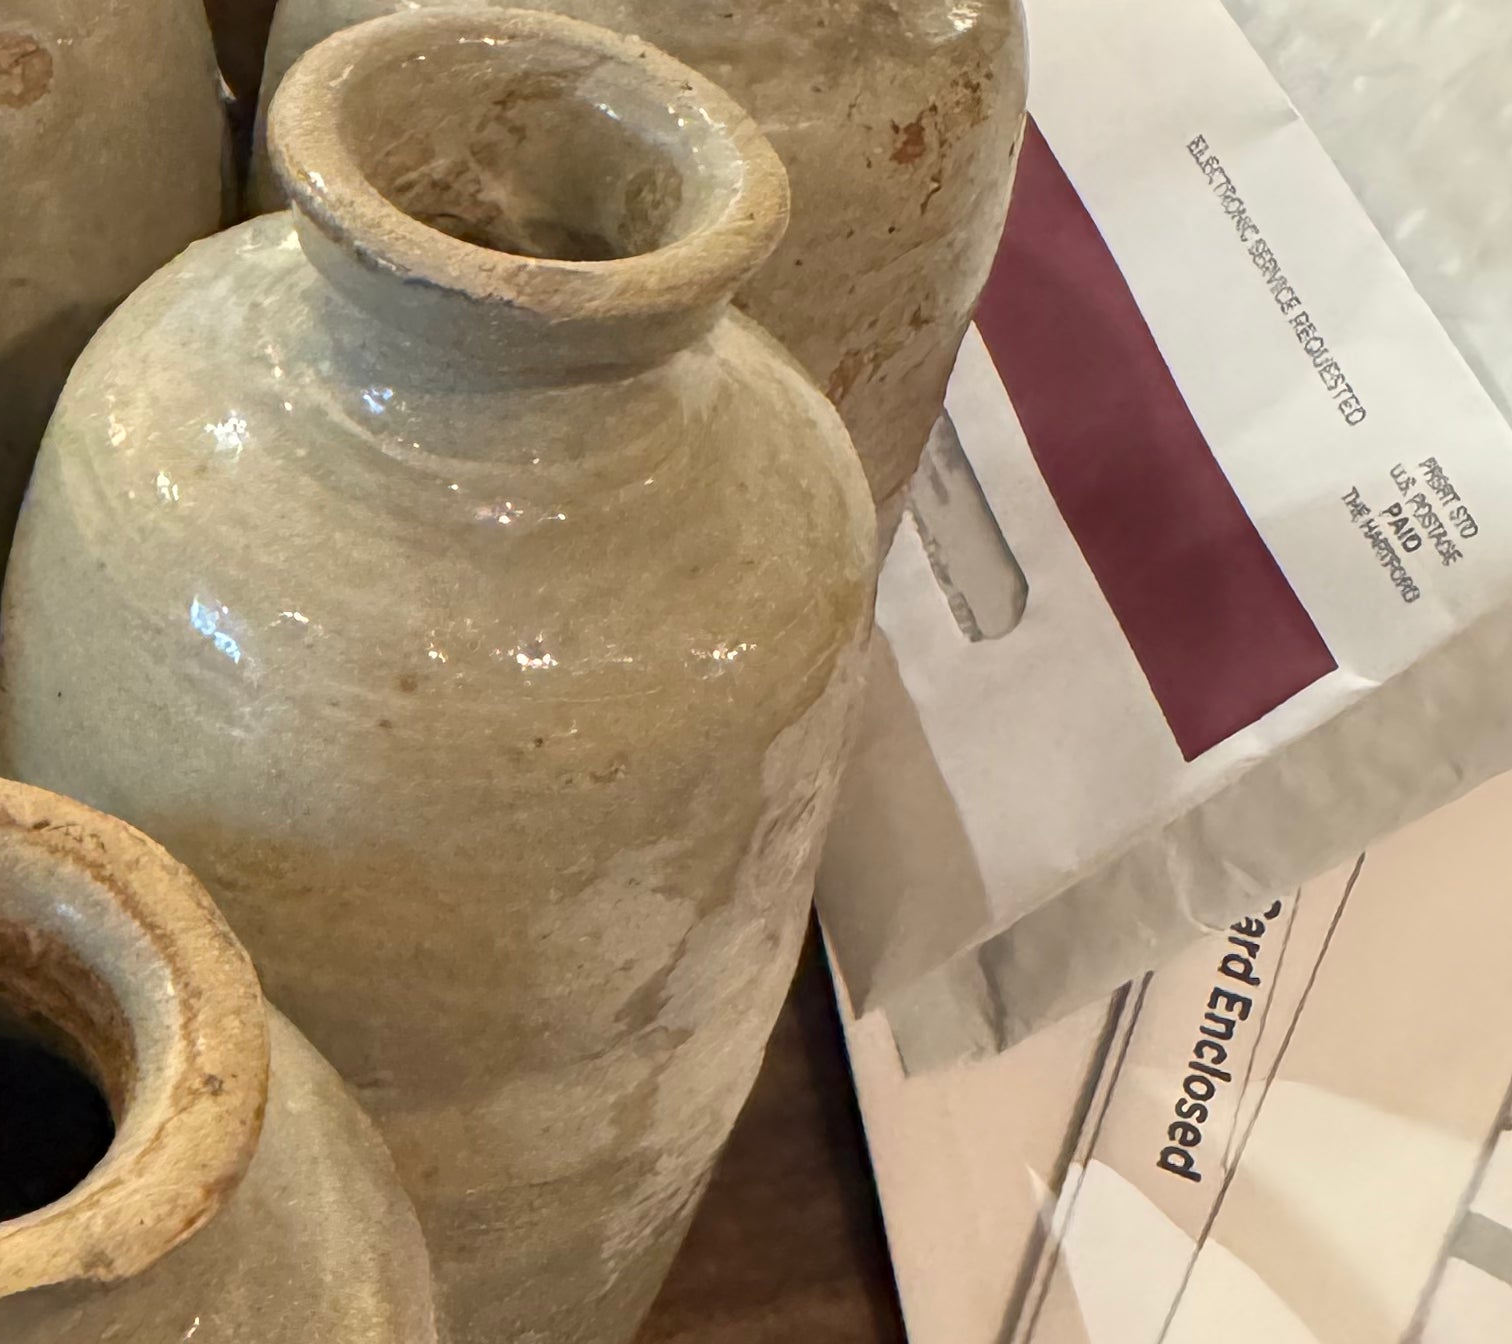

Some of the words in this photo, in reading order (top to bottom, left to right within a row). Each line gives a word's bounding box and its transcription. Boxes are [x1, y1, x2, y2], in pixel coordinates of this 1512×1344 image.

[1186, 134, 1259, 242] ELECTRONIC
[1248, 238, 1301, 315] SERVICE
[1289, 311, 1366, 426] REQUESTED
[1341, 486, 1371, 523] THE
[1359, 517, 1420, 603] HARTFORD
[1381, 502, 1422, 553] PAID
[1405, 492, 1464, 567] POSTAGE
[1450, 505, 1479, 539] STD
[1156, 986, 1253, 1183] Enclosed
